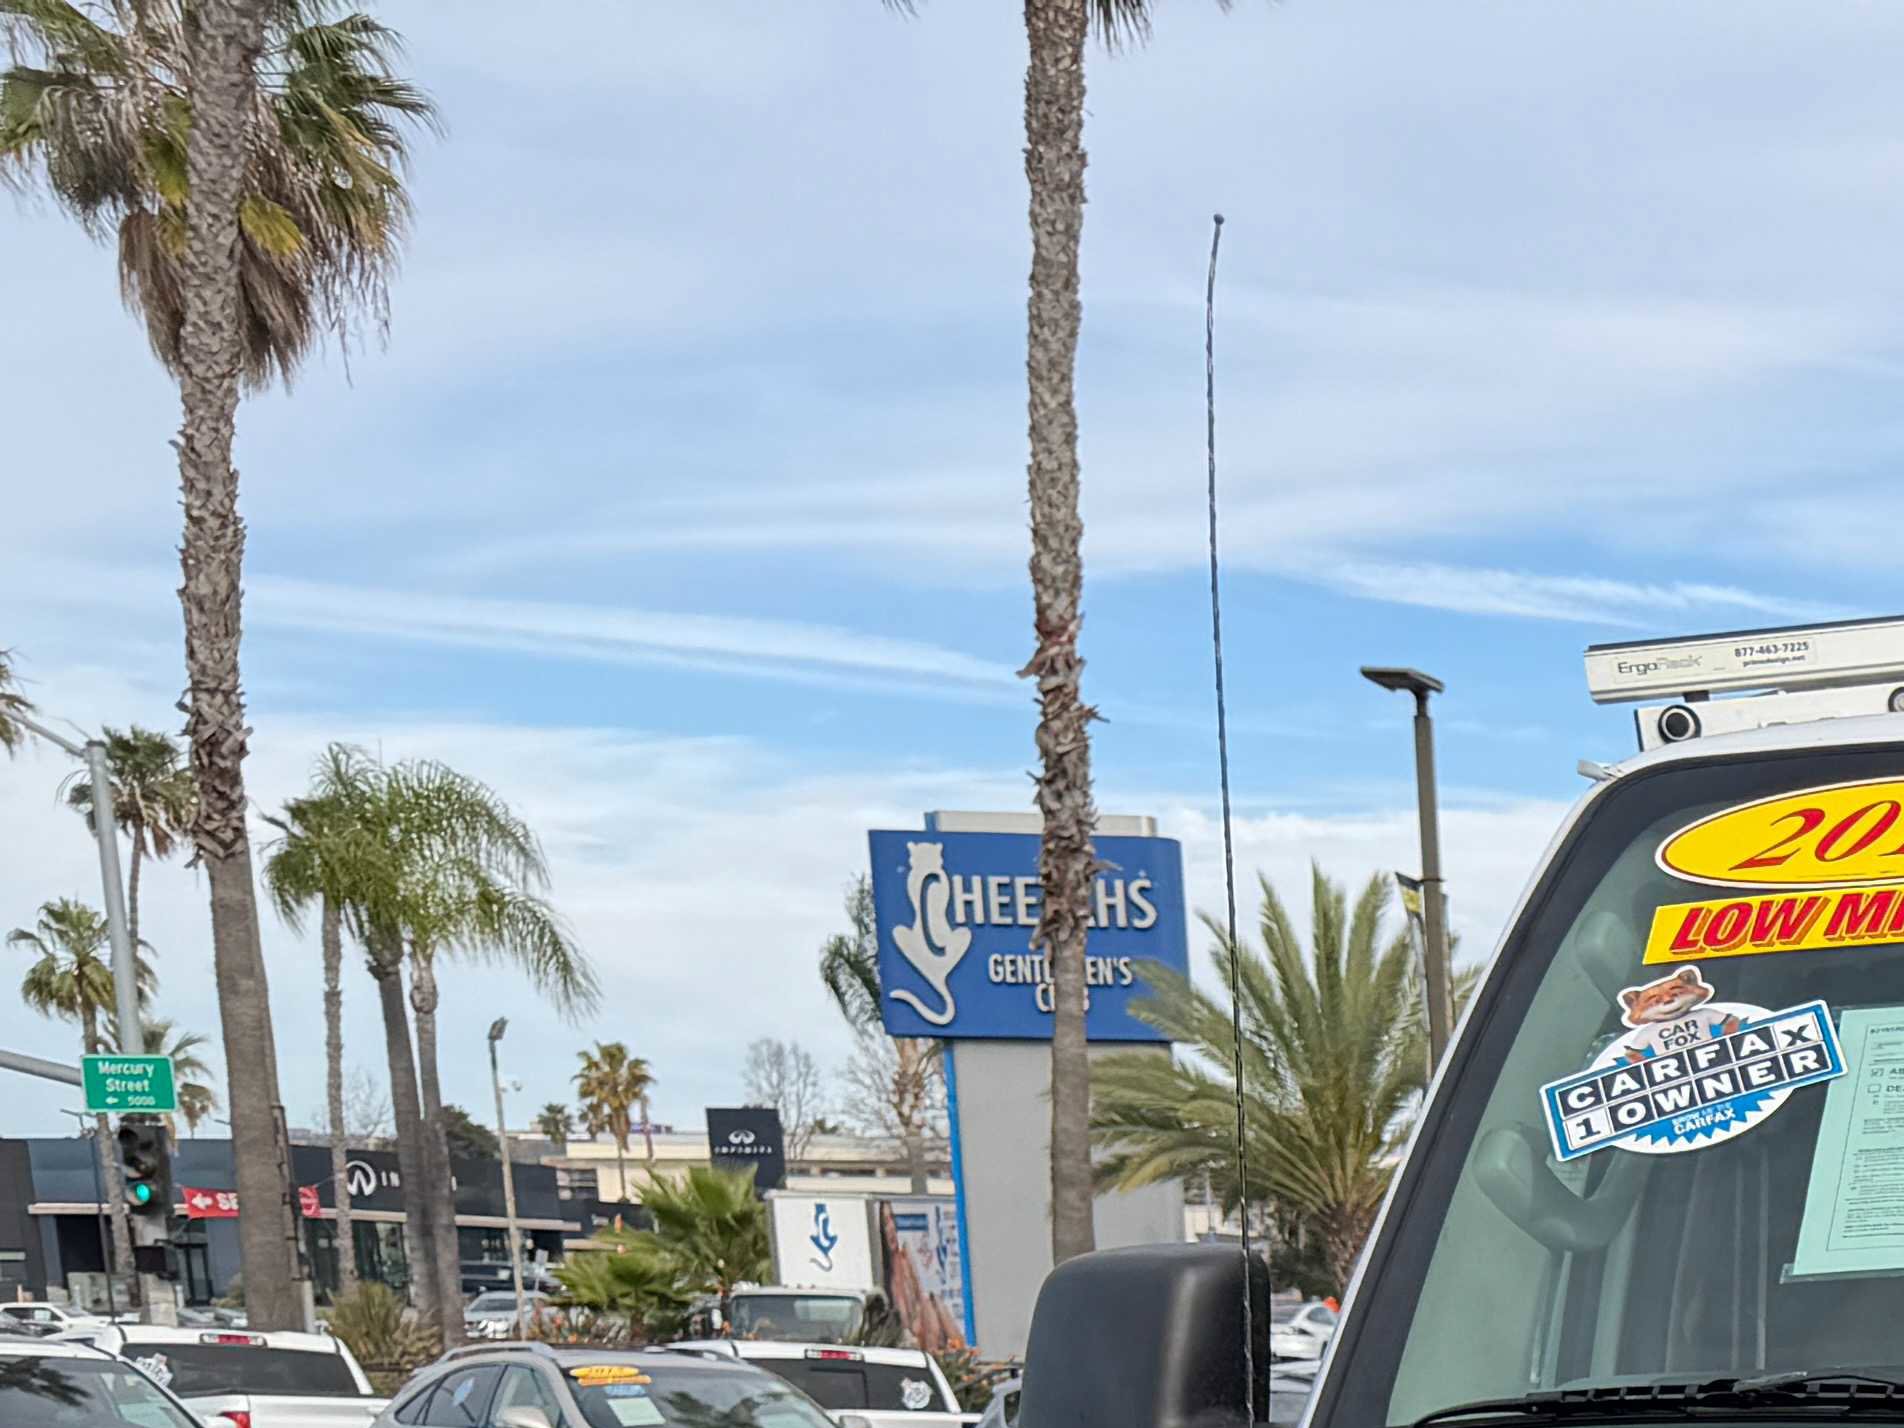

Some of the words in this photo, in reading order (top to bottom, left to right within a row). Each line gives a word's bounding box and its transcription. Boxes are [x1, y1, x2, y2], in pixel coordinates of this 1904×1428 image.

[1670, 895, 1827, 956] LOW
[988, 953, 1134, 986] GENTLEN'S
[1657, 1018, 1700, 1041] CAR
[1663, 1030, 1702, 1051] FOX
[97, 1060, 155, 1078] Mercury
[1566, 1023, 1811, 1111] CARFAX
[105, 1078, 151, 1092] Street
[1574, 1117, 1602, 1142] 1
[1615, 1048, 1823, 1126] OWNER
[1673, 1107, 1737, 1136] CARFAX
